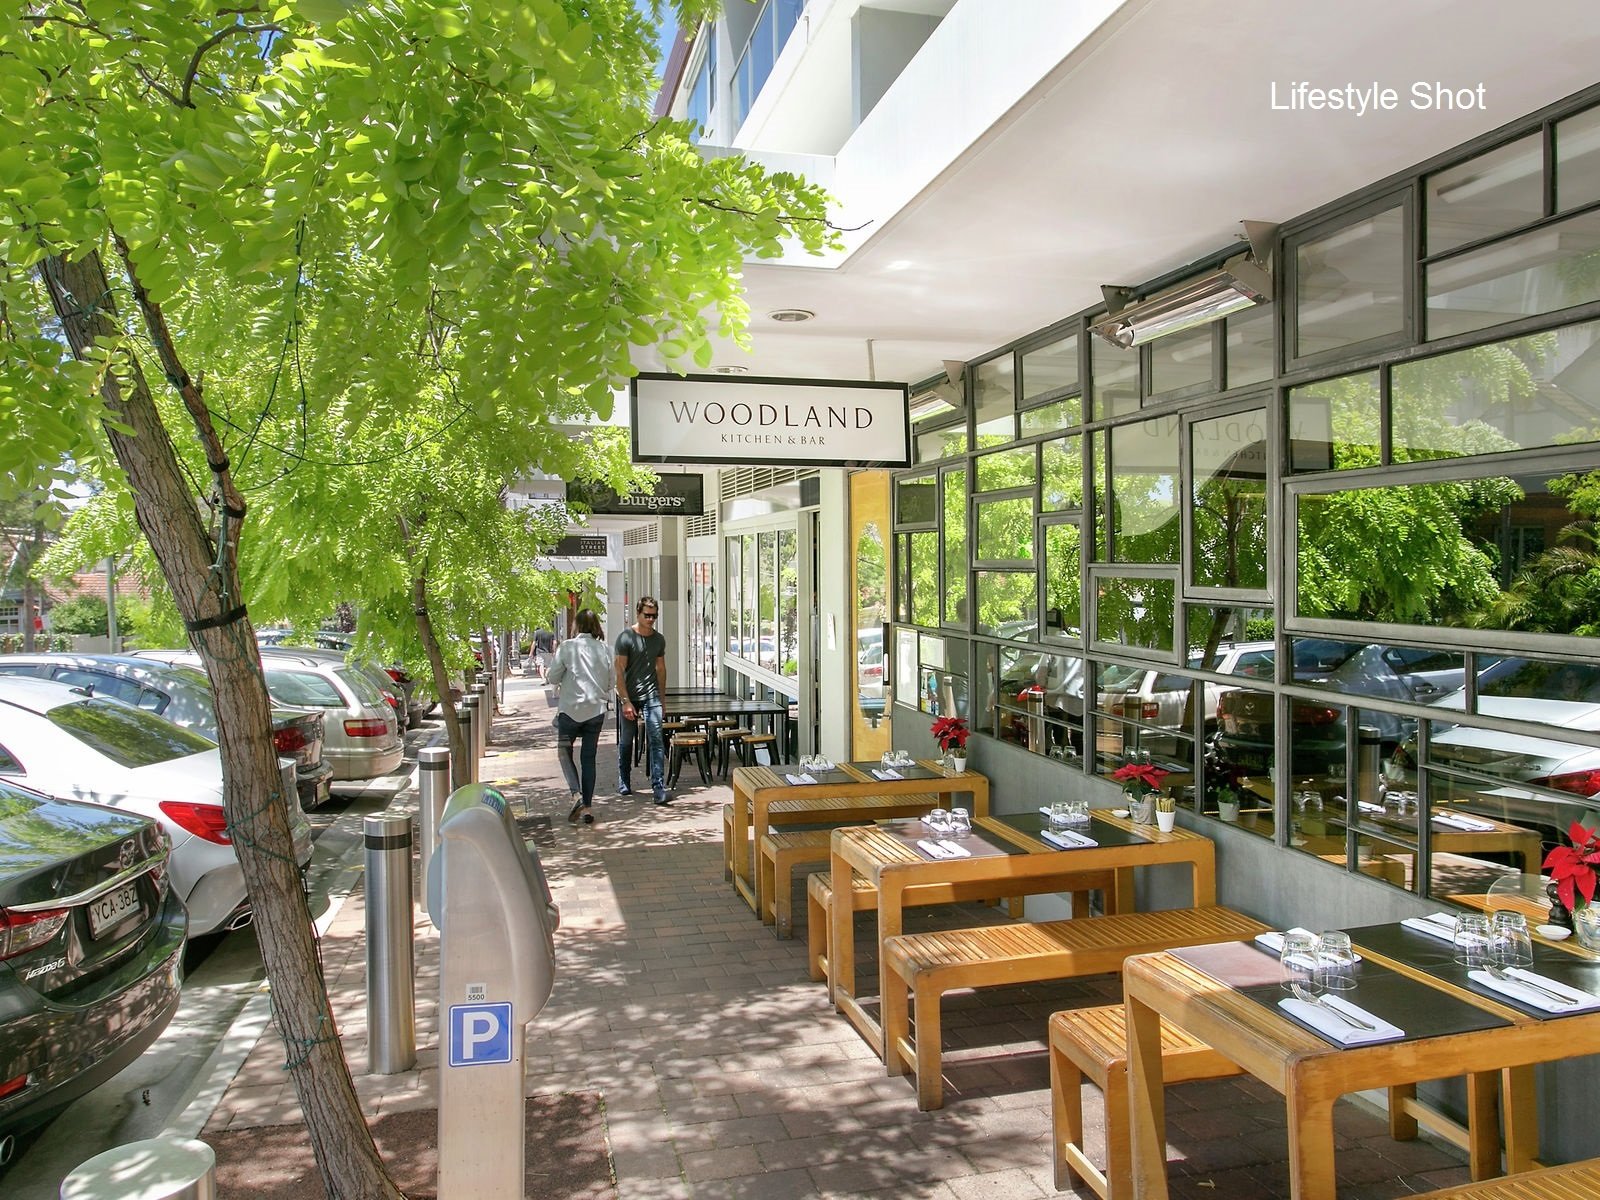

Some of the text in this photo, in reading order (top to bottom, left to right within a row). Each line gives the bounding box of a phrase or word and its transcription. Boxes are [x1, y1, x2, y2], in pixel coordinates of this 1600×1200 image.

[669, 401, 873, 429] WOODLAND
[721, 433, 825, 445] KITCHEN & BAR
[468, 993, 485, 1001] 5500
[463, 1011, 499, 1060] P
